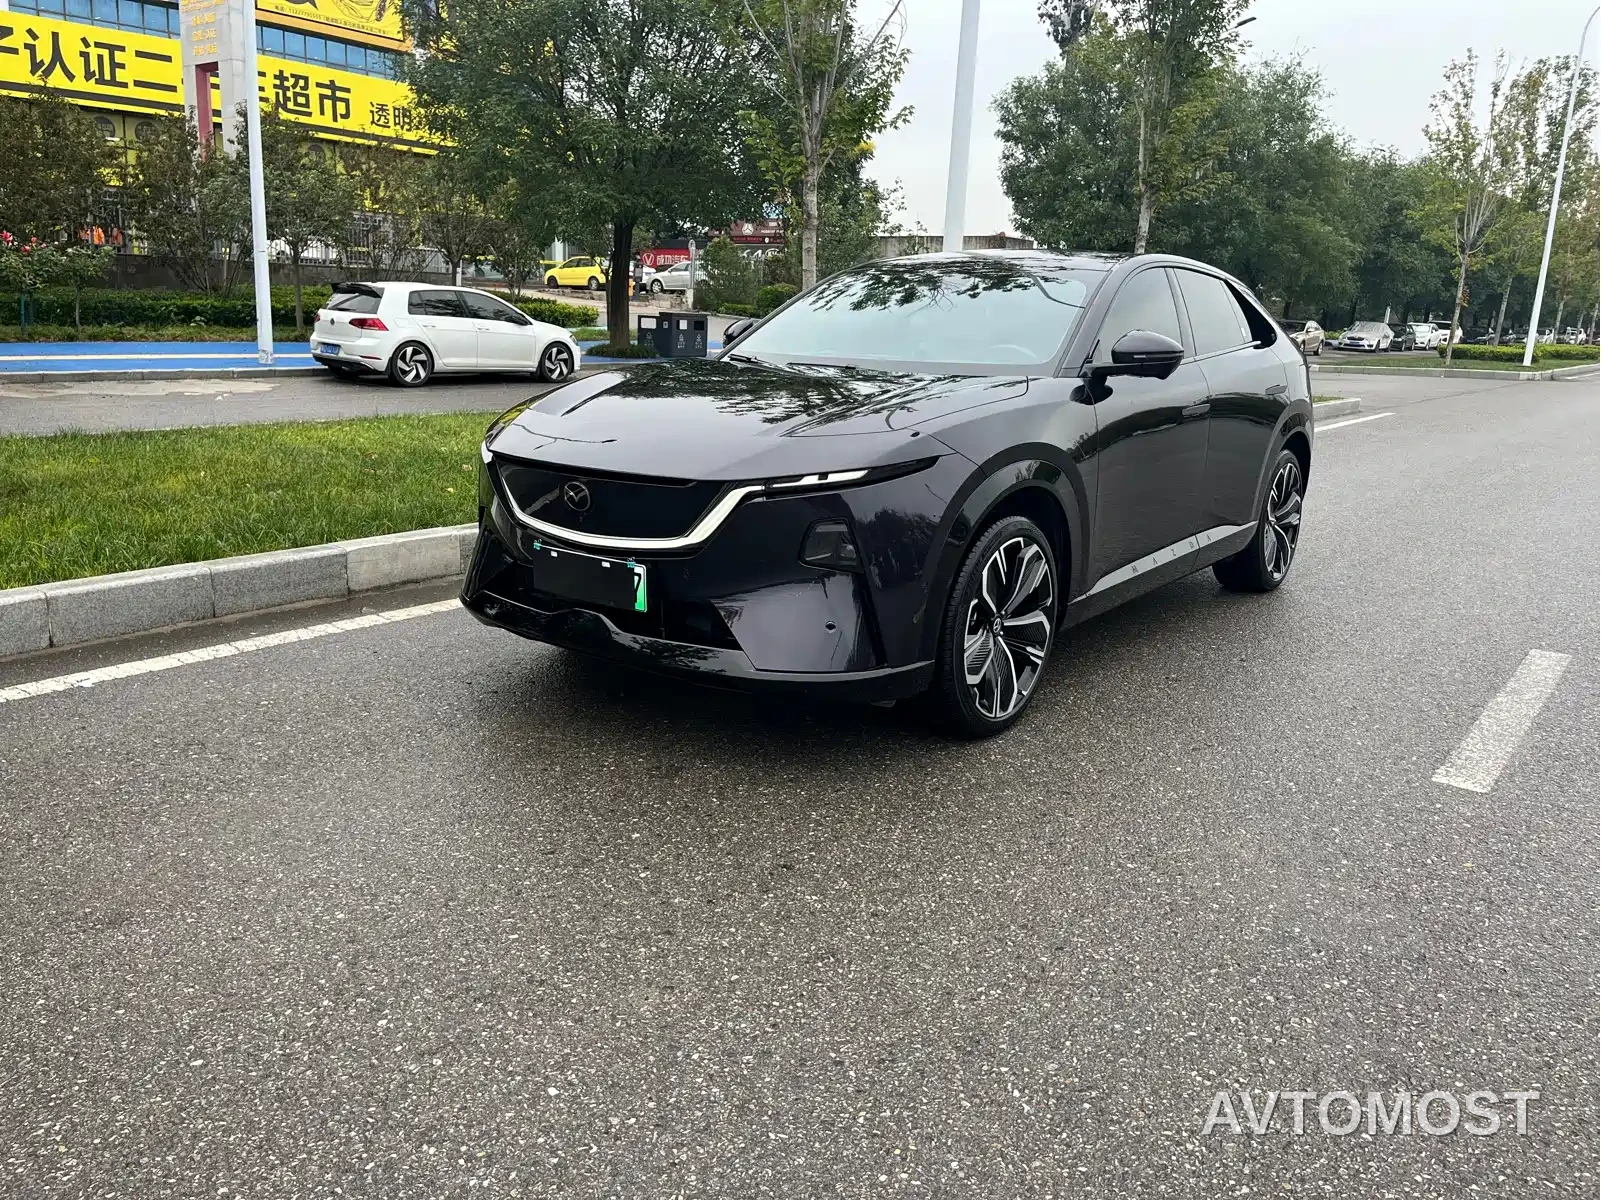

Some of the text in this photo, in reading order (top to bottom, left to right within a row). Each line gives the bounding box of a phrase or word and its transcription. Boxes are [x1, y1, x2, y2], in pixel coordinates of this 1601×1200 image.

[0, 25, 352, 123] 认证二超市
[1130, 534, 1212, 574] MAZDA
